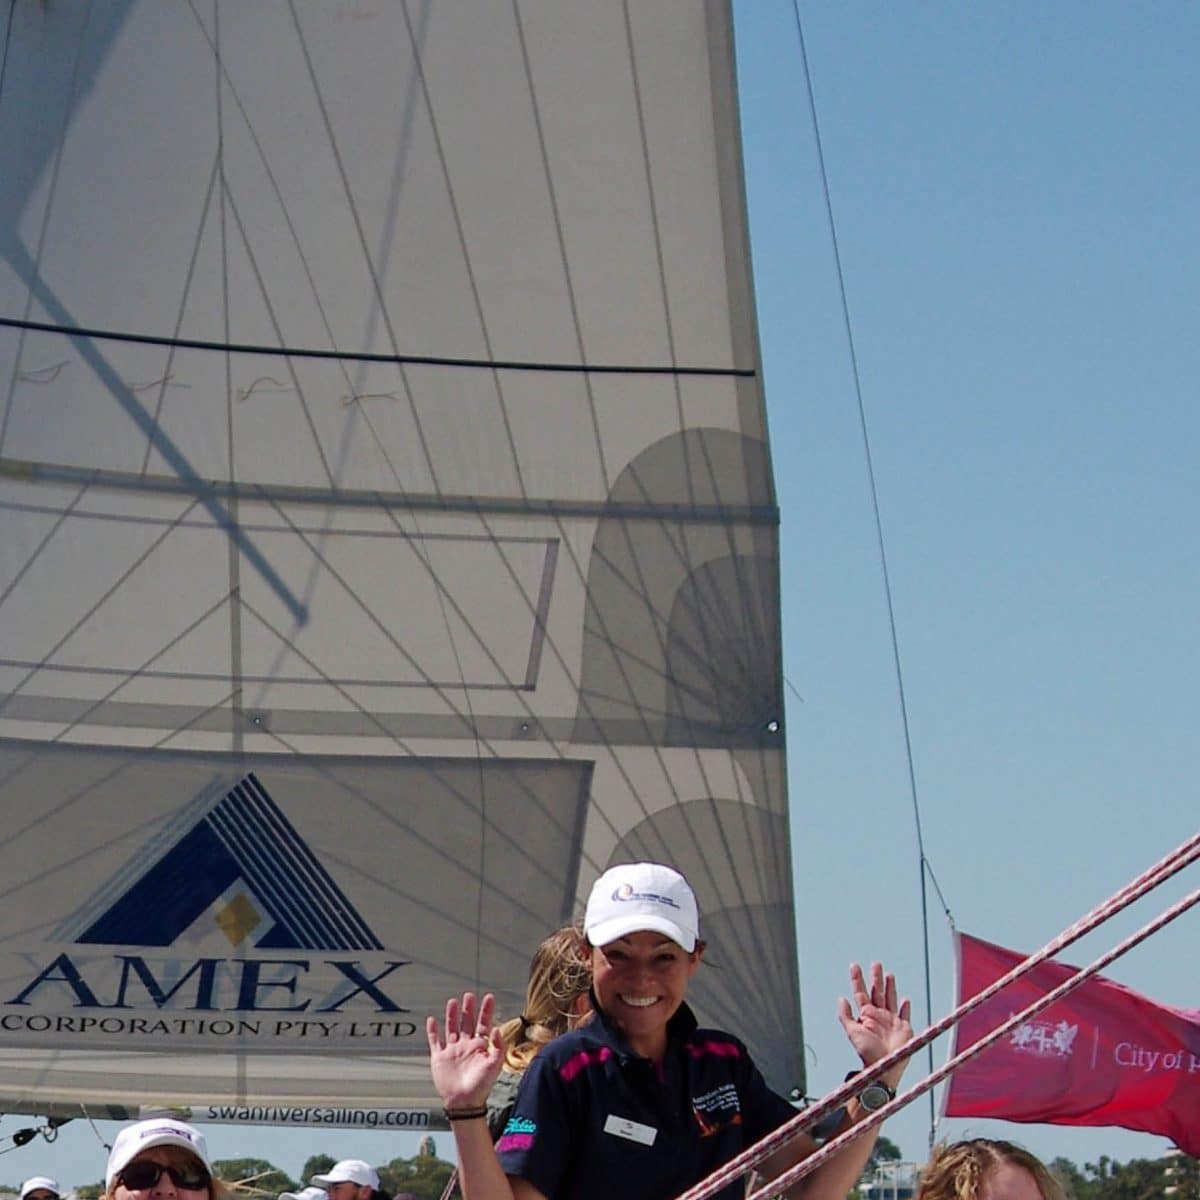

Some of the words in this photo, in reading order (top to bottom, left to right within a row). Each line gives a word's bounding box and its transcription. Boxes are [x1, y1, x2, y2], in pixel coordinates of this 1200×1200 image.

[3, 951, 413, 1014] AMEX
[1, 1013, 262, 1037] CORPORATION
[275, 1020, 340, 1038] PTY
[349, 1021, 417, 1039] LTD
[1114, 1041, 1161, 1073] City
[1162, 1049, 1185, 1070] of
[207, 1103, 430, 1128] swanriversailing.com
